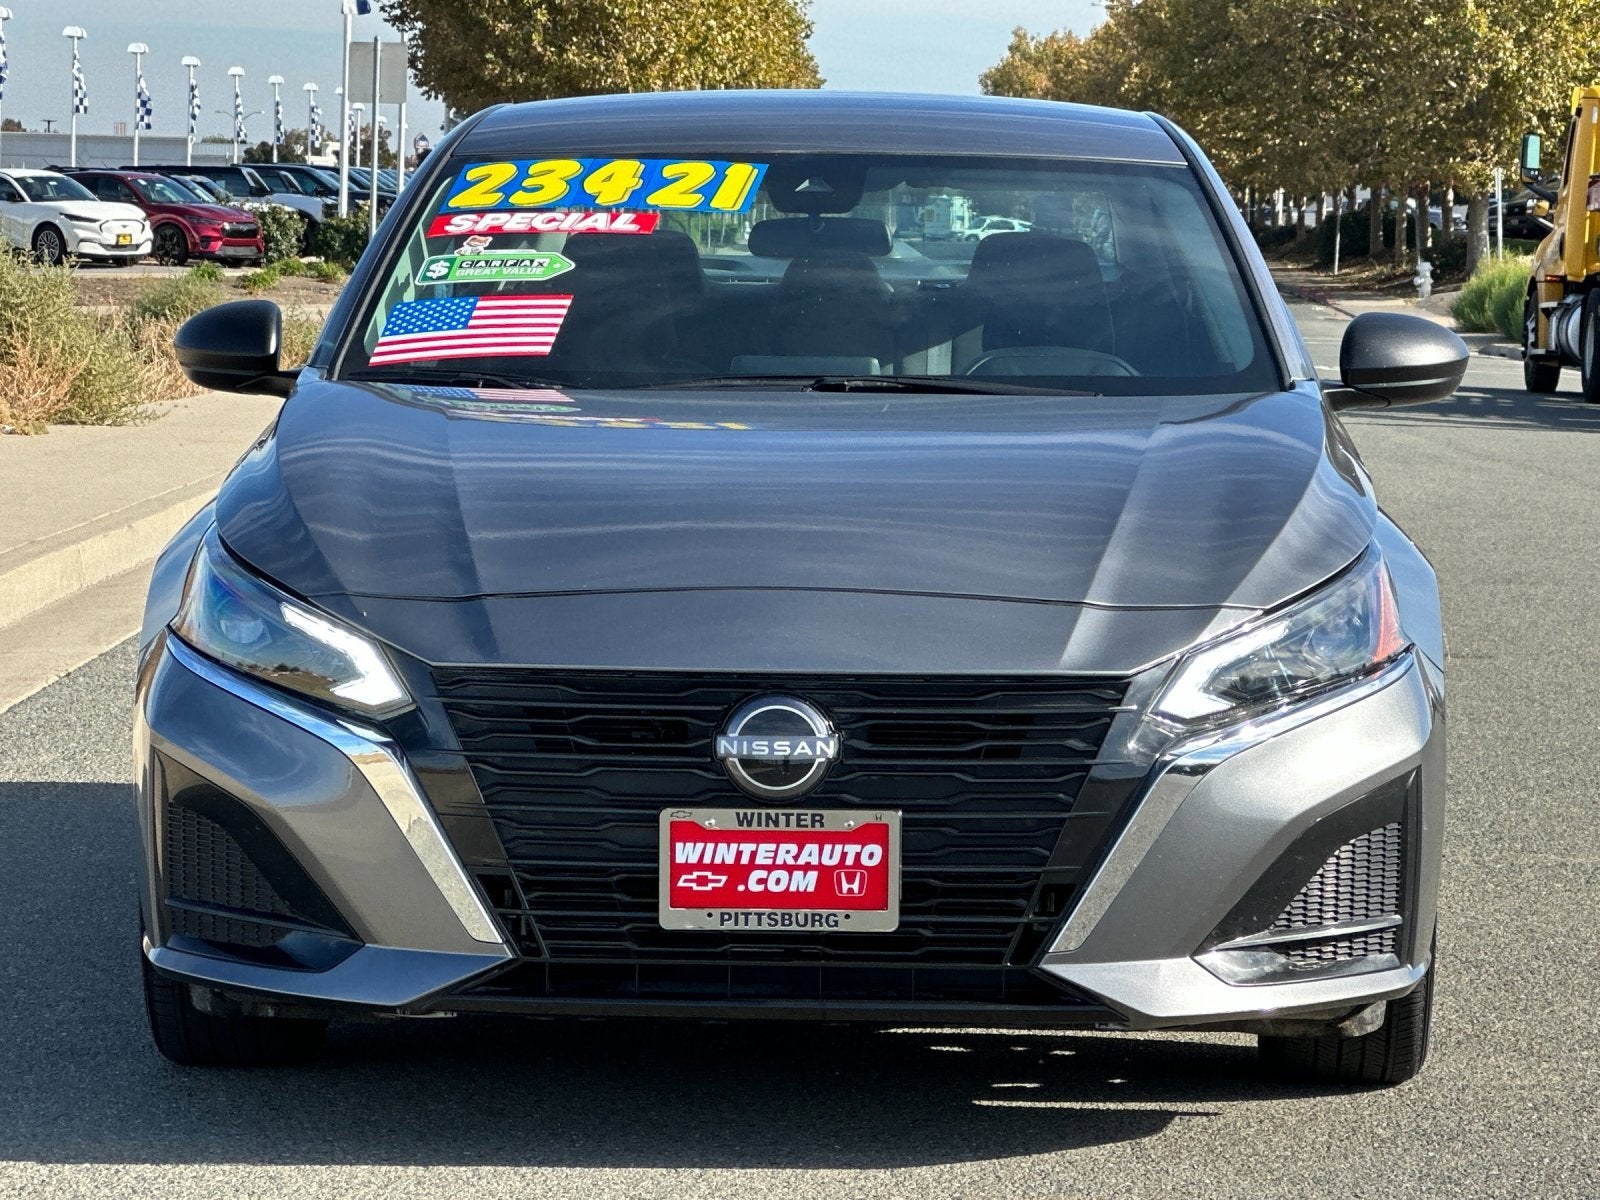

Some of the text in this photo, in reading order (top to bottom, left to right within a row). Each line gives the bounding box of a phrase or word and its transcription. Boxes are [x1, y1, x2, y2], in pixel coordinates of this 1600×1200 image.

[448, 160, 757, 210] 23421
[444, 212, 641, 233] SPECIAL
[455, 267, 545, 277] GREAT VALUE
[460, 258, 549, 268] CARFAX
[719, 739, 835, 757] NISSAN
[735, 811, 825, 829] WINTER
[675, 842, 883, 866] WINTERAUTO
[737, 870, 818, 892] .COM
[719, 911, 840, 929] PITTSBURG
